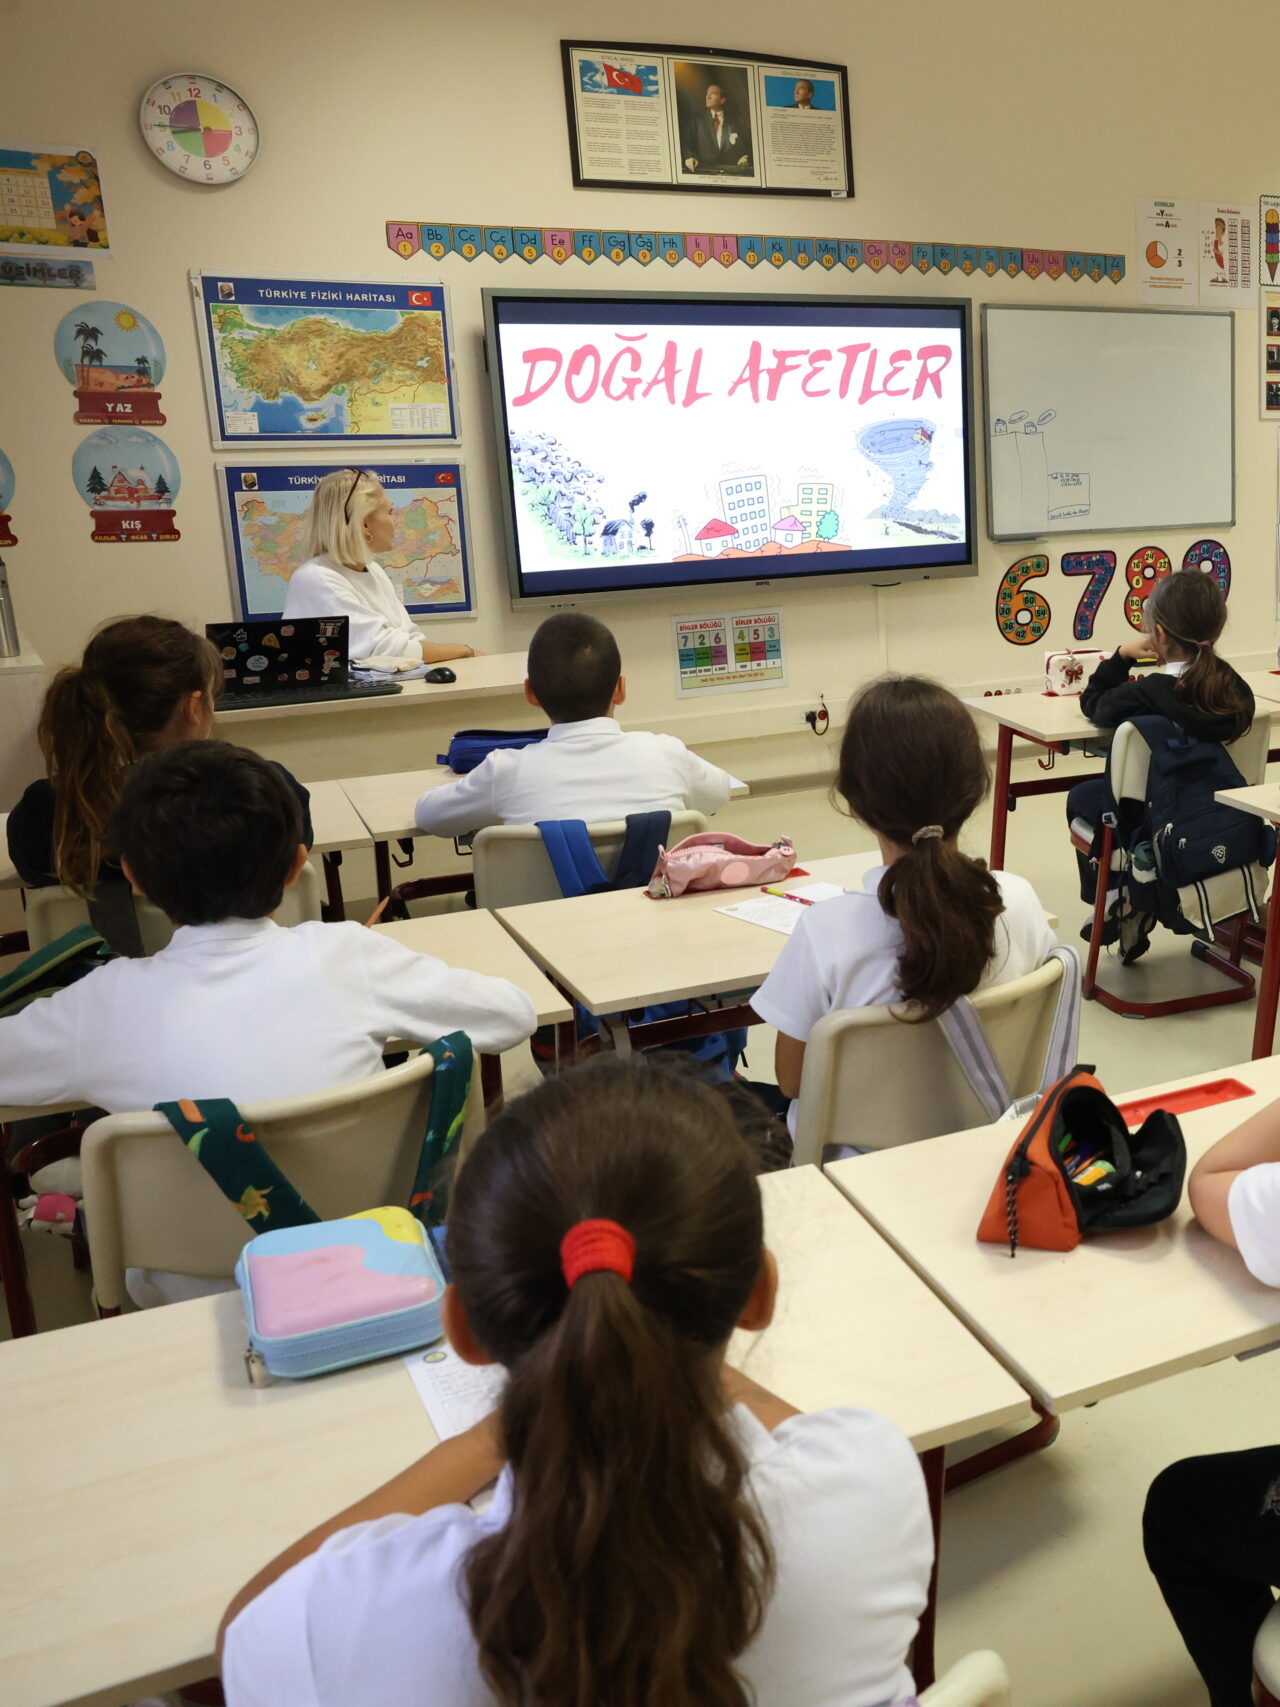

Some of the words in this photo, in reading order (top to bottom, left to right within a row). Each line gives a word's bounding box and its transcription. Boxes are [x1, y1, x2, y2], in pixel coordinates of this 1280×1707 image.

[187, 88, 201, 98] 12
[158, 105, 171, 115] 10
[235, 126, 242, 136] 3
[166, 141, 175, 151] 8
[234, 144, 241, 153] 4
[183, 155, 190, 164] 7
[222, 156, 230, 165] 5
[203, 160, 211, 170] 6
[396, 228, 413, 240] Aa
[428, 229, 443, 241] Bb
[458, 230, 475, 242] Cc
[521, 234, 536, 245] Dd
[551, 235, 565, 245] Ee
[582, 235, 592, 248] Ff
[608, 236, 625, 251] Gg
[663, 238, 677, 249] Hh
[772, 242, 783, 252] Kk
[819, 243, 837, 253] Mm
[846, 245, 858, 254] Nn
[867, 245, 882, 255] Oo
[497, 247, 504, 255] 4
[258, 288, 307, 300] TÜRKİYE
[311, 290, 342, 301] FİZİKİ
[347, 291, 396, 303] HARİTASI
[512, 332, 712, 408] DOĞAL
[728, 340, 952, 405] AFETLER
[106, 402, 132, 413] YAZ
[288, 476, 322, 485] TÜRKİY
[379, 475, 405, 483] RİTASI
[122, 520, 142, 531] KIŞ
[996, 554, 1051, 645] 6
[1061, 550, 1117, 640] 7
[1124, 546, 1172, 634] 8
[754, 616, 776, 624] BÖLÜĞÜ
[700, 622, 722, 630] BÖLÜĞÜ
[737, 630, 745, 641] 4
[753, 629, 760, 640] 5
[768, 627, 775, 639] 3
[681, 635, 689, 647] 7
[698, 634, 706, 646] 2
[714, 633, 722, 644] 6
